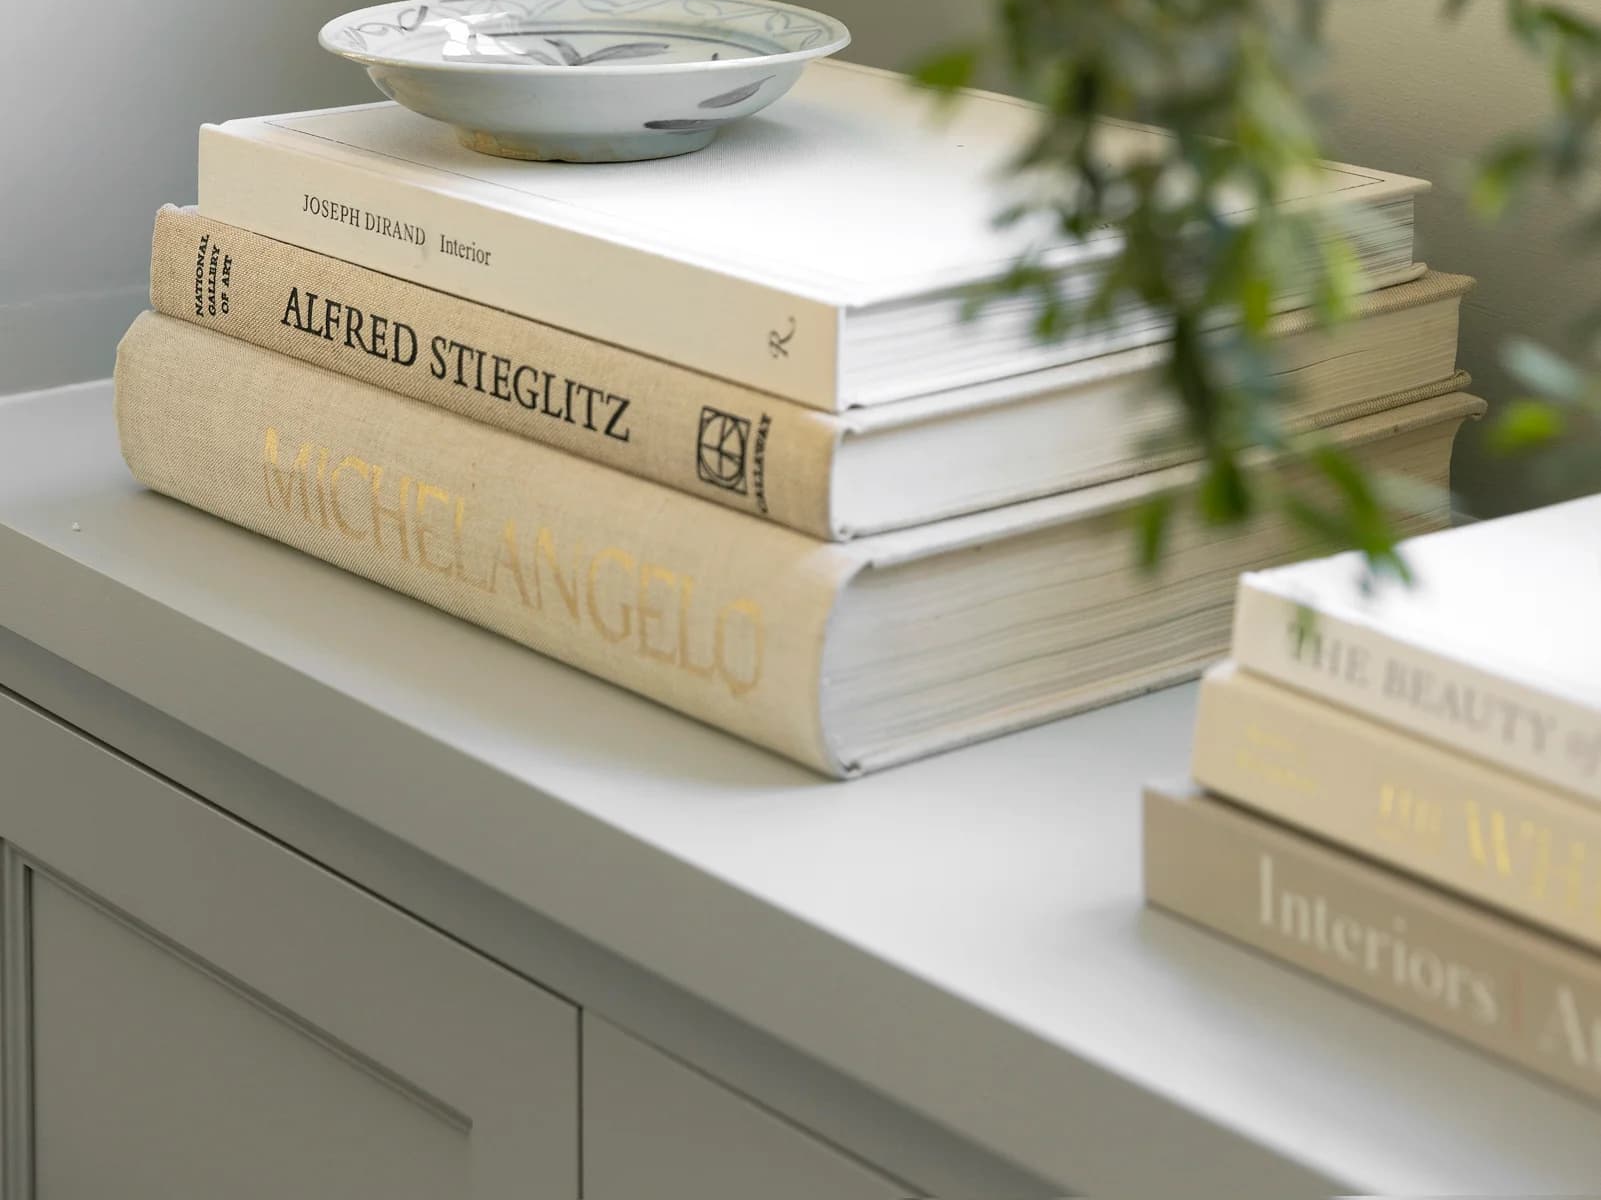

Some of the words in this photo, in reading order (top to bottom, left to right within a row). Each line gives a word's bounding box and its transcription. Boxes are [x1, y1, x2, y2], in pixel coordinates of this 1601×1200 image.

[195, 234, 210, 317] NATIONAL
[221, 254, 232, 288] ART
[303, 194, 360, 228] JOSEPH
[365, 212, 426, 246] DIRAND
[440, 234, 491, 266] Interior
[208, 244, 220, 316] GALLERY
[221, 292, 229, 314] OF
[281, 287, 418, 367] ALFRED
[430, 336, 630, 443] STIEGLITZ
[753, 412, 772, 513] CALLAWAY
[263, 426, 766, 696] MICHELANGELO
[1381, 657, 1558, 756] BEAUTY
[1259, 854, 1497, 1027] Interiors
